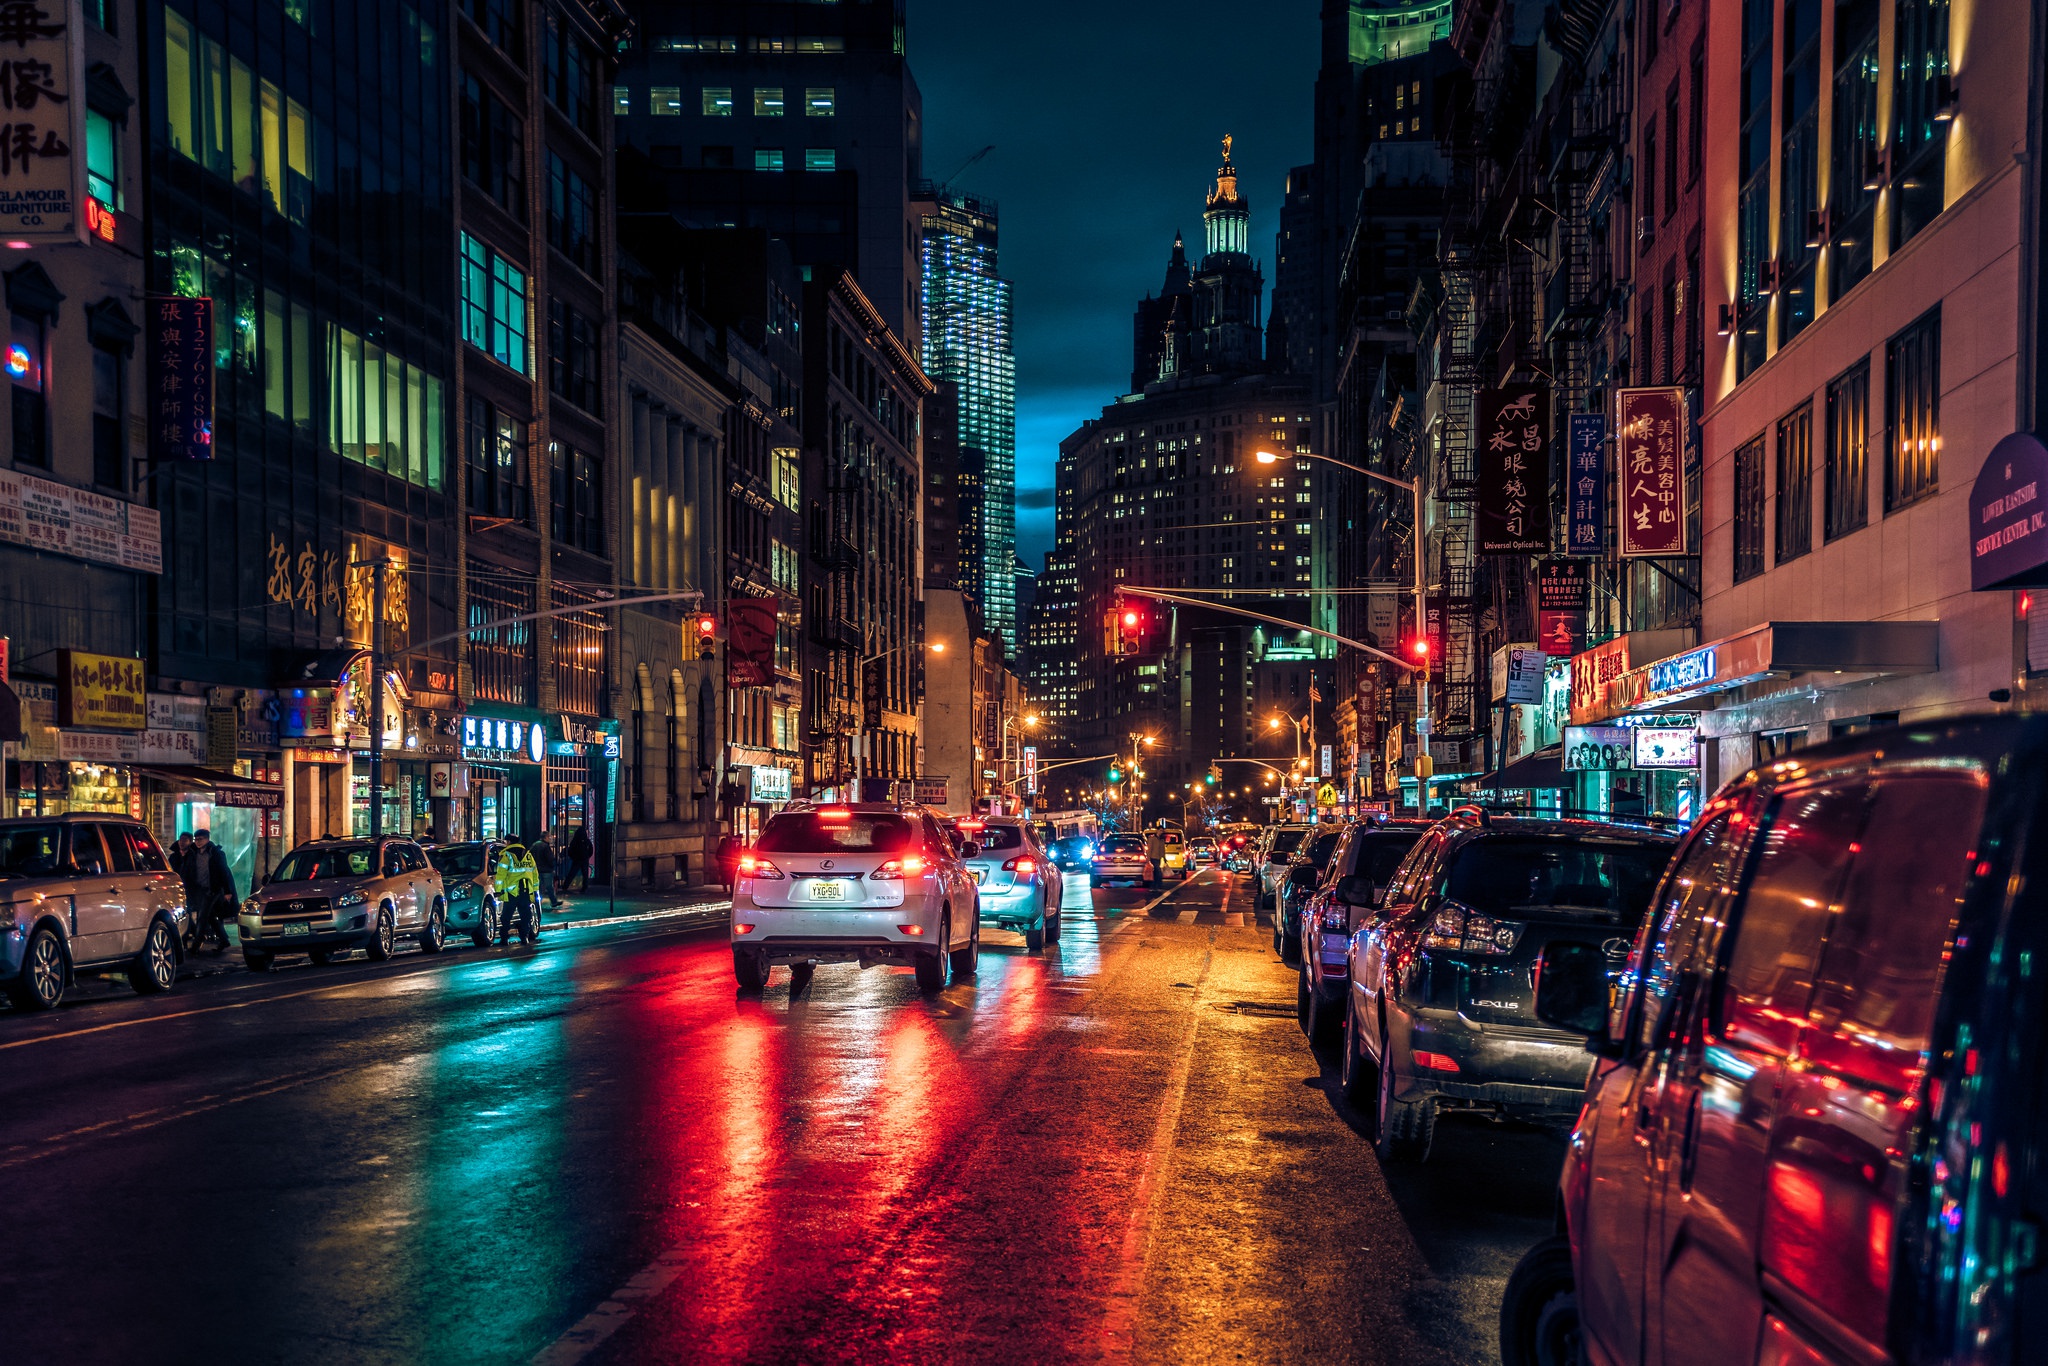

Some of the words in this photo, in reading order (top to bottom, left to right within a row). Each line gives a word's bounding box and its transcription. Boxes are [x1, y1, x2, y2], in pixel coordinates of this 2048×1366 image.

[0, 202, 71, 214] URNITURE
[21, 214, 44, 226] CO.
[1488, 423, 1542, 452] 永昌
[1630, 413, 1658, 531] 漂亮人生
[1657, 419, 1676, 523] 美髮美容中心
[1502, 452, 1528, 537] 眼鏡公司
[1575, 428, 1598, 544] 宇華會計樓
[1976, 531, 2002, 557] SERVICE
[2031, 511, 2046, 533] INC.
[1484, 541, 1511, 549] Universal
[1512, 541, 1534, 550] Optical
[1535, 540, 1546, 549] Inc.
[732, 668, 748, 676] Public
[732, 676, 755, 684] Library
[1360, 696, 1374, 746] 喜來登
[426, 744, 454, 754] CENTER
[1471, 999, 1519, 1009] LEXUS
